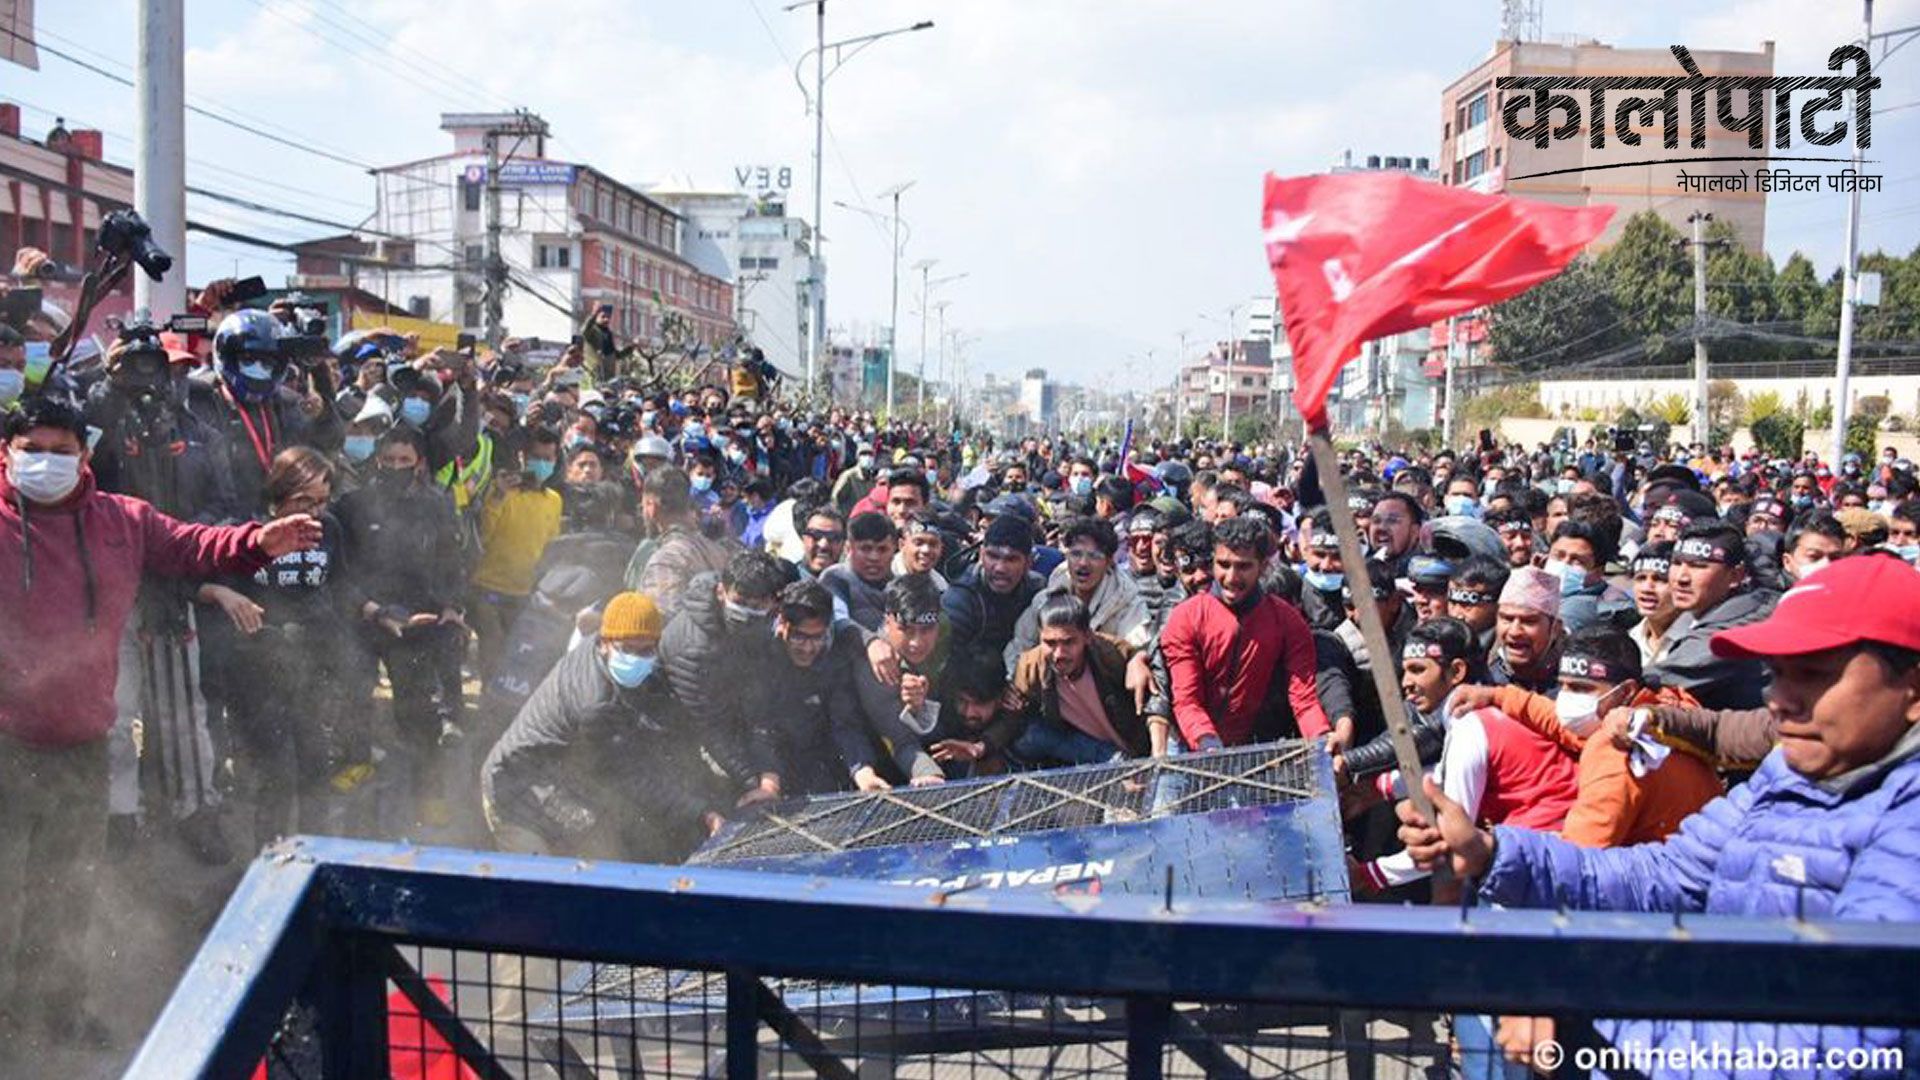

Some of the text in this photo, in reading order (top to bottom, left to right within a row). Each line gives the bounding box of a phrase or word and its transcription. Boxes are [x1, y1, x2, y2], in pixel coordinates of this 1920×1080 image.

[1682, 538, 1712, 557] MCC
[1643, 559, 1669, 573] MCC
[980, 860, 1115, 889] NEPAL
